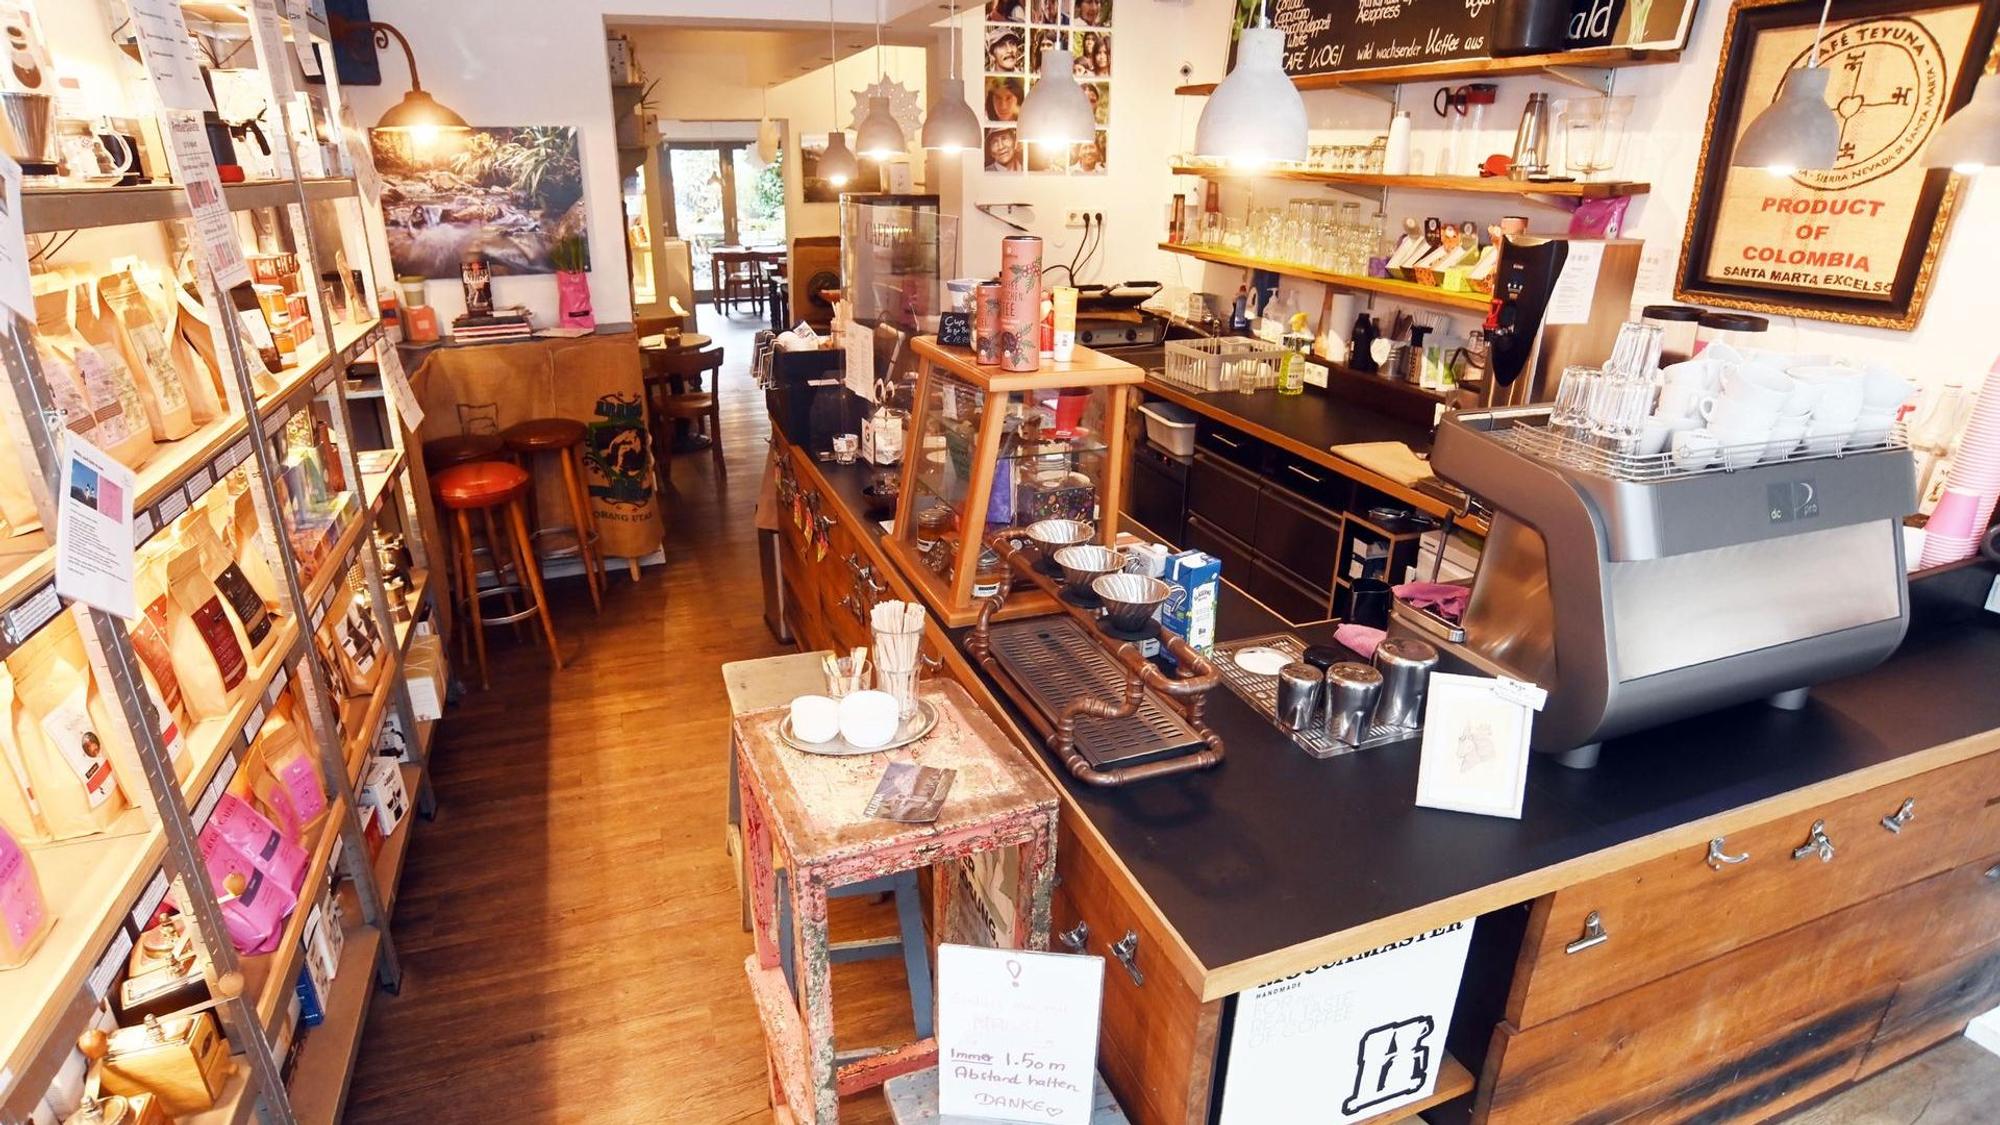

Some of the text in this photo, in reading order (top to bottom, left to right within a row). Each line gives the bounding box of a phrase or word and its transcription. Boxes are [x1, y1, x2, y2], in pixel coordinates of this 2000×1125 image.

[1568, 0, 1614, 39] ald
[1309, 44, 1345, 69] KOGI
[1357, 41, 1375, 60] wild
[1425, 27, 1460, 55] Kaffee
[1464, 35, 1484, 51] aus
[1813, 27, 1926, 60] AFÉ TEYUNA
[1852, 154, 1896, 180] NEVADA
[1906, 110, 1930, 144] SANTA
[1925, 65, 1937, 107] MARTA
[1761, 196, 1886, 217] PRODUCT
[1795, 224, 1830, 241] OF
[1742, 246, 1870, 273] COLOMBIA
[1723, 265, 1767, 280] SANTA
[1769, 270, 1818, 285] MARTA
[1256, 982, 1302, 999] HANDMADE
[954, 1066, 1080, 1093] Abstand halten
[974, 1091, 1046, 1111] DANKE
